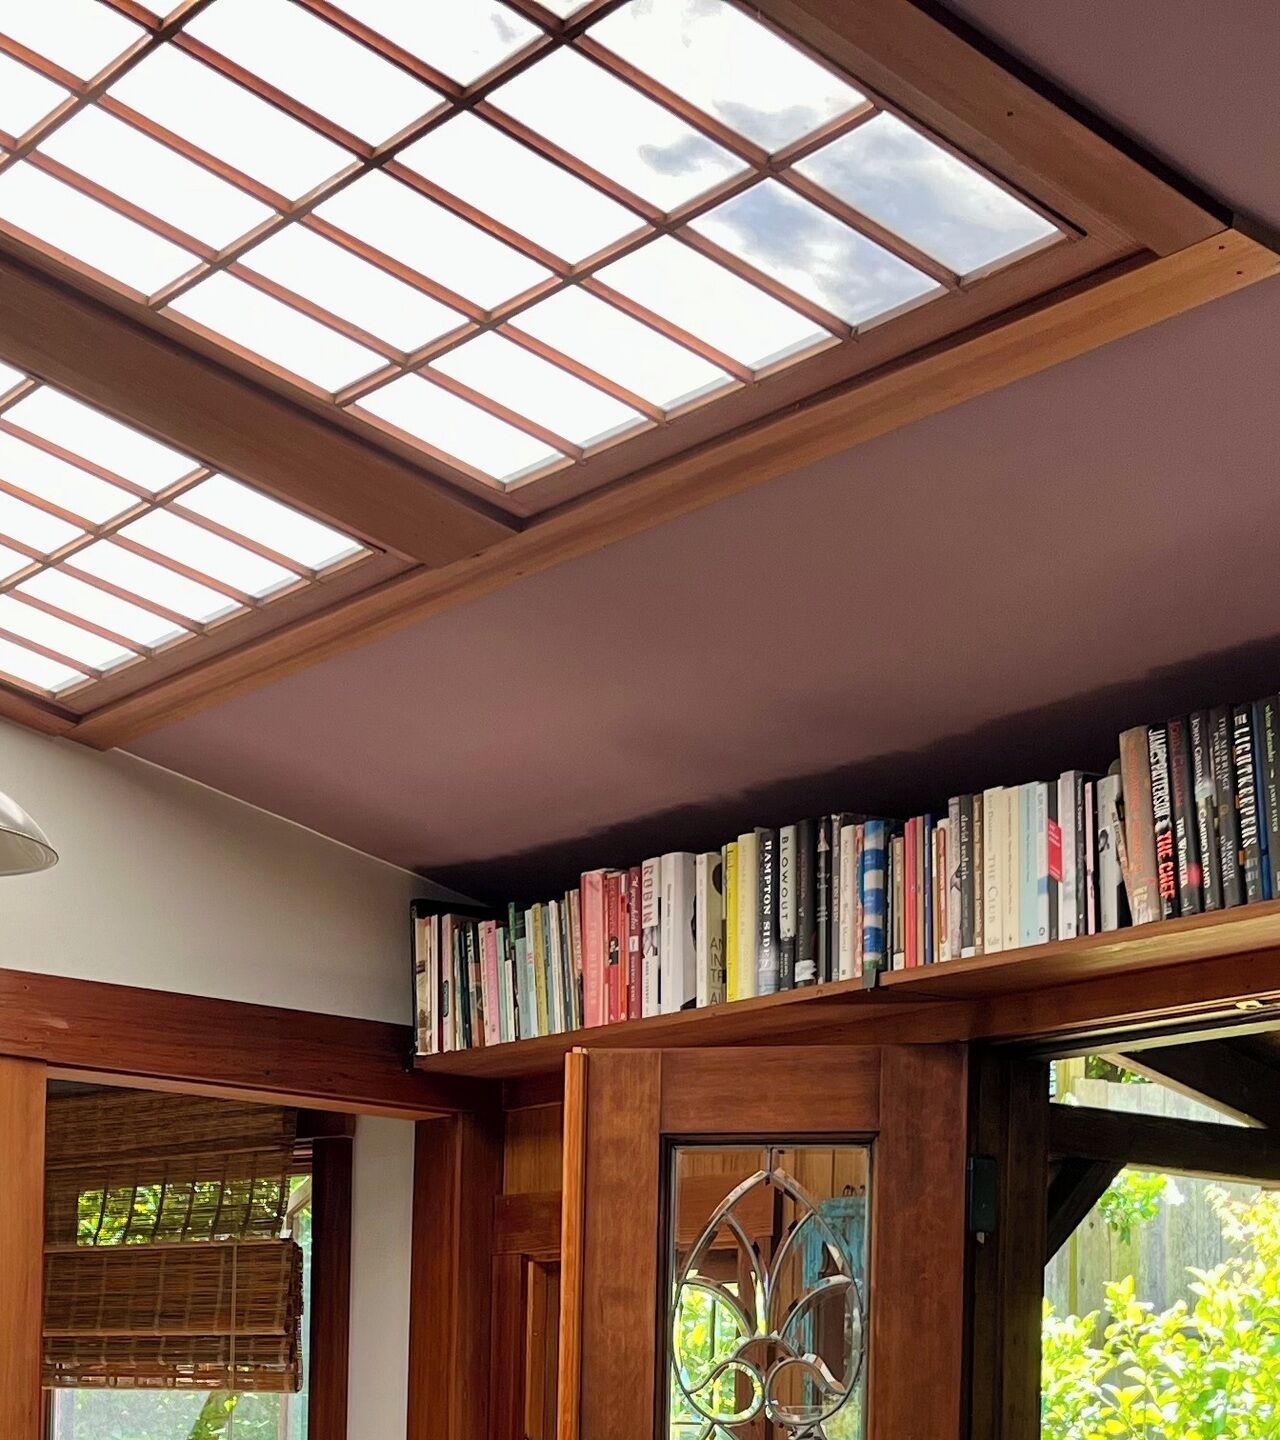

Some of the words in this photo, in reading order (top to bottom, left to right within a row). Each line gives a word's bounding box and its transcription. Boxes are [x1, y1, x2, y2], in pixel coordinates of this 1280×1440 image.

[1233, 726, 1258, 849] LIGHTKEEPERS
[960, 815, 970, 842] david
[1154, 830, 1173, 859] THE
[642, 864, 655, 924] ROBIN
[762, 840, 773, 915] HAMPTON
[780, 836, 789, 921] BLOWOUT
[1158, 861, 1176, 899] CHEF
[761, 920, 772, 969] SIDES
